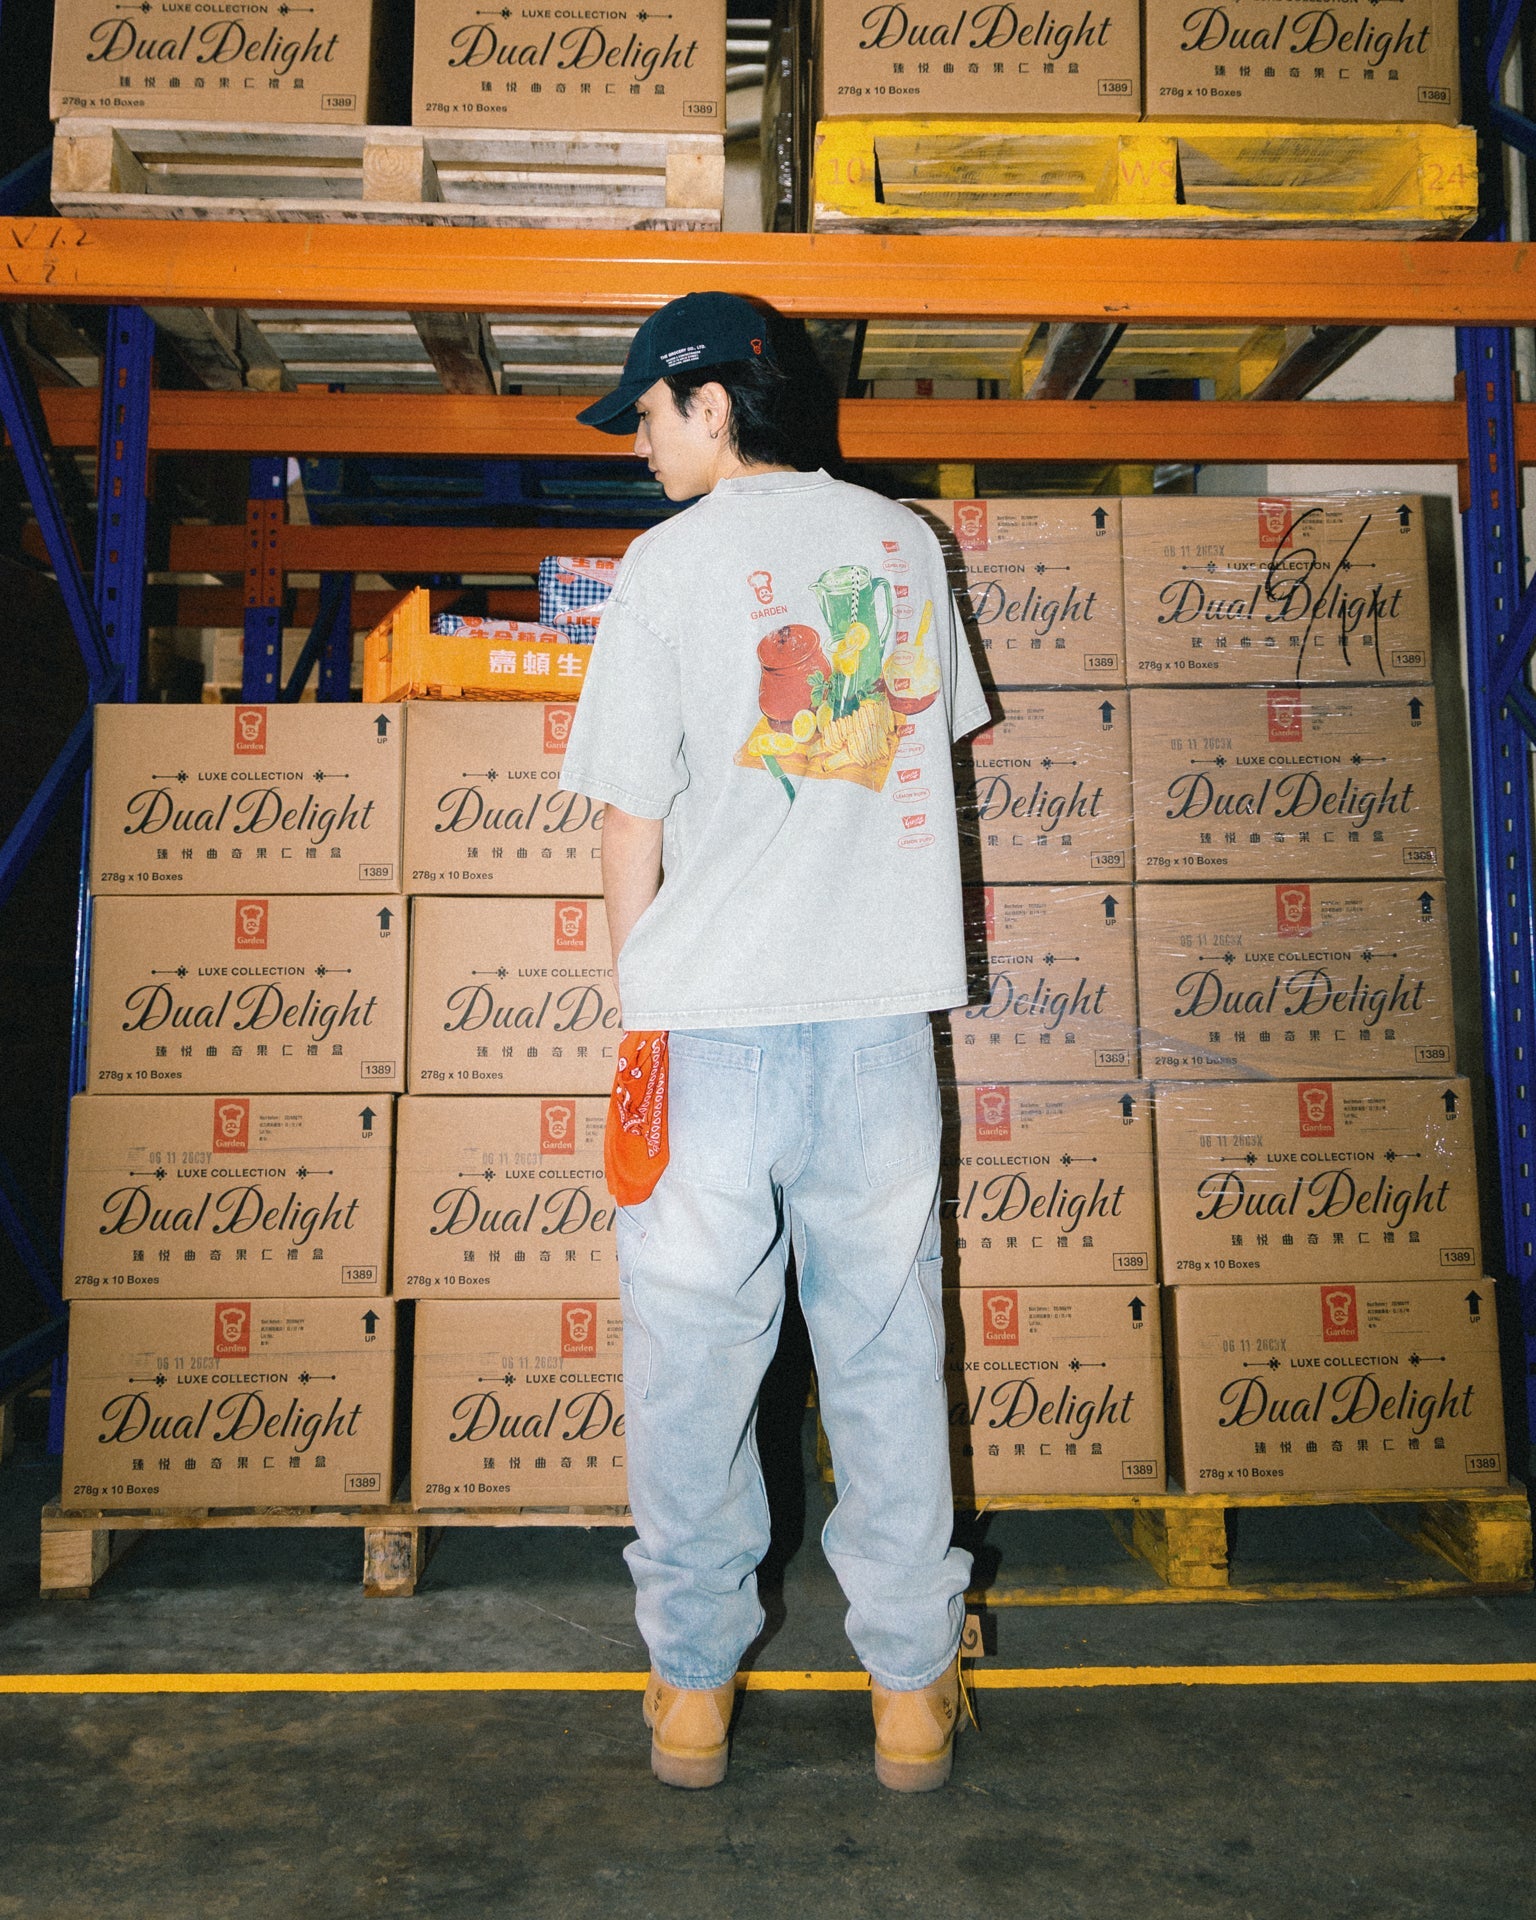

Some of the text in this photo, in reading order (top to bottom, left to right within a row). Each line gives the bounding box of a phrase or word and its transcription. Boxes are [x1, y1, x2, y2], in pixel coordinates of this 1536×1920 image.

[522, 9, 627, 20] LUXE COLLECTION
[859, 2, 1112, 60] Dual Delight
[1180, 5, 1431, 67] Dual Delight
[86, 17, 339, 76] Dual Delight
[448, 23, 698, 82] Dual Delight
[1102, 82, 1128, 92] 1389
[1422, 90, 1447, 100] 1389
[326, 98, 352, 108] 1389
[425, 102, 450, 113] 278g
[462, 103, 474, 112] 10
[476, 103, 508, 113] Boxes
[687, 104, 713, 114] 1389
[1427, 163, 1467, 191] 24
[958, 579, 1097, 636] Delight
[1157, 576, 1403, 633] Dual Delight
[750, 604, 788, 620] GARDEN
[1089, 657, 1114, 667] 1389
[1396, 654, 1422, 664] 1389
[1188, 738, 1197, 750] 11
[1236, 755, 1340, 765] LUXE COLLECTION
[198, 771, 303, 781] LUXE COLLECTION
[963, 774, 1103, 832] Delight
[1166, 770, 1414, 829] Dual Delight
[434, 785, 542, 833] Dual
[123, 786, 375, 845] Dual Delight
[1095, 854, 1120, 864] 1389
[363, 867, 389, 877] 1389
[237, 936, 265, 944] Garden
[198, 966, 305, 976] LUXE COLLECTION
[518, 968, 613, 978] LUXE COLLECTIO
[965, 970, 1107, 1030] Delight
[1174, 967, 1426, 1027] Dual Delight
[122, 982, 377, 1042] Dual Delight
[443, 983, 553, 1032] Dual
[1419, 1049, 1446, 1059] 1389
[98, 1070, 124, 1081] 278g
[136, 1070, 148, 1079] 10
[150, 1070, 182, 1079] Boxes
[366, 1064, 391, 1075] 1389
[420, 1070, 445, 1081] 278g
[457, 1070, 469, 1080] 10
[472, 1070, 503, 1080] Boxes
[215, 1138, 246, 1148] Garden
[1217, 1135, 1227, 1147] 11
[167, 1152, 176, 1164] 11
[975, 1155, 1050, 1166] COLLECTION
[1267, 1152, 1374, 1163] LUXE COLLECTION
[177, 1168, 285, 1179] LUXE COLLECTION
[505, 1170, 606, 1180] LUXE COLLECTIO
[981, 1171, 1125, 1233] Delight
[1196, 1167, 1450, 1229] Dual Delight
[99, 1184, 359, 1246] Dual Delight
[429, 1185, 540, 1236] Dual
[1118, 1256, 1144, 1267] 1389
[1445, 1251, 1471, 1262] 1389
[1176, 1260, 1202, 1272] 278g
[1213, 1260, 1226, 1269] 10
[1228, 1259, 1260, 1269] Boxes
[347, 1269, 373, 1280] 1389
[986, 1331, 1017, 1340] Garden
[564, 1344, 594, 1353] Garden
[1240, 1339, 1250, 1352] 11
[175, 1357, 184, 1369] 11
[519, 1356, 529, 1369] 11
[983, 1361, 1058, 1371] COLLECTION
[1290, 1356, 1398, 1368] LUXE COLLECTION
[177, 1373, 288, 1385] LUXE COLLECTION
[988, 1377, 1135, 1440] Delight
[1219, 1372, 1475, 1435] Dual Delight
[98, 1389, 362, 1453] Dual Delight
[449, 1390, 561, 1443] Dual
[1470, 1457, 1496, 1469] 1389
[1127, 1464, 1154, 1475] 1389
[350, 1477, 376, 1488] 1389
[73, 1484, 160, 1497] 278g x 10 Boxes
